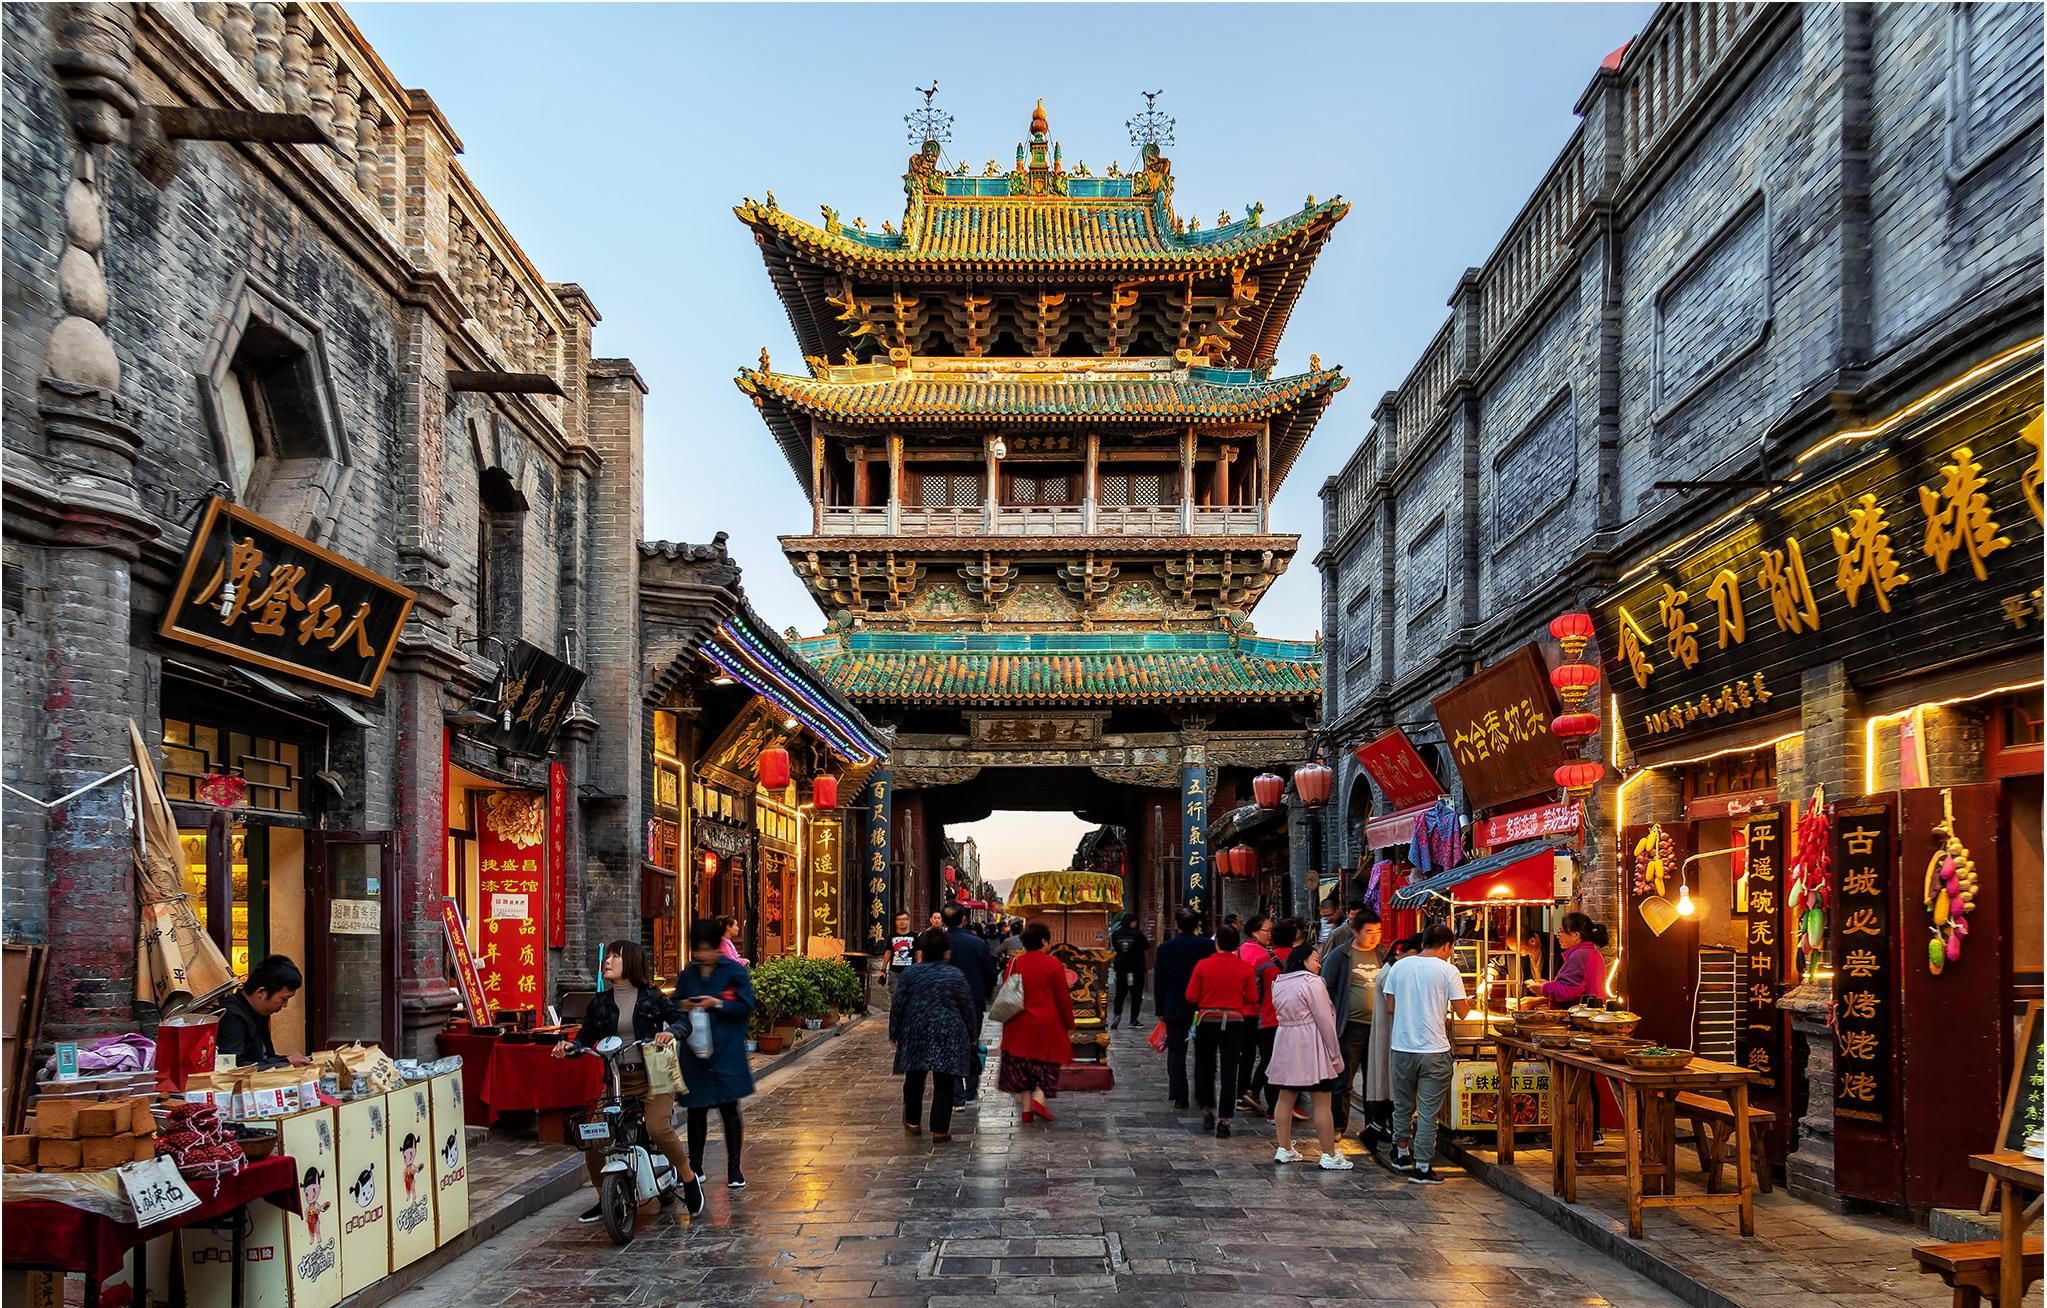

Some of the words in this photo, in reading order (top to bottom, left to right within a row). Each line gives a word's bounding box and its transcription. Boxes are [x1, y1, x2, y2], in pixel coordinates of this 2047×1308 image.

[193, 537, 376, 658] 摩登红人
[1454, 696, 1546, 765] 六合泰枕头
[481, 859, 537, 872] 捷盛昌
[481, 879, 538, 893] 漆艺馆
[334, 903, 377, 920] 招聘服务员
[1749, 824, 1776, 1073] 平遥碗秃中华一绝
